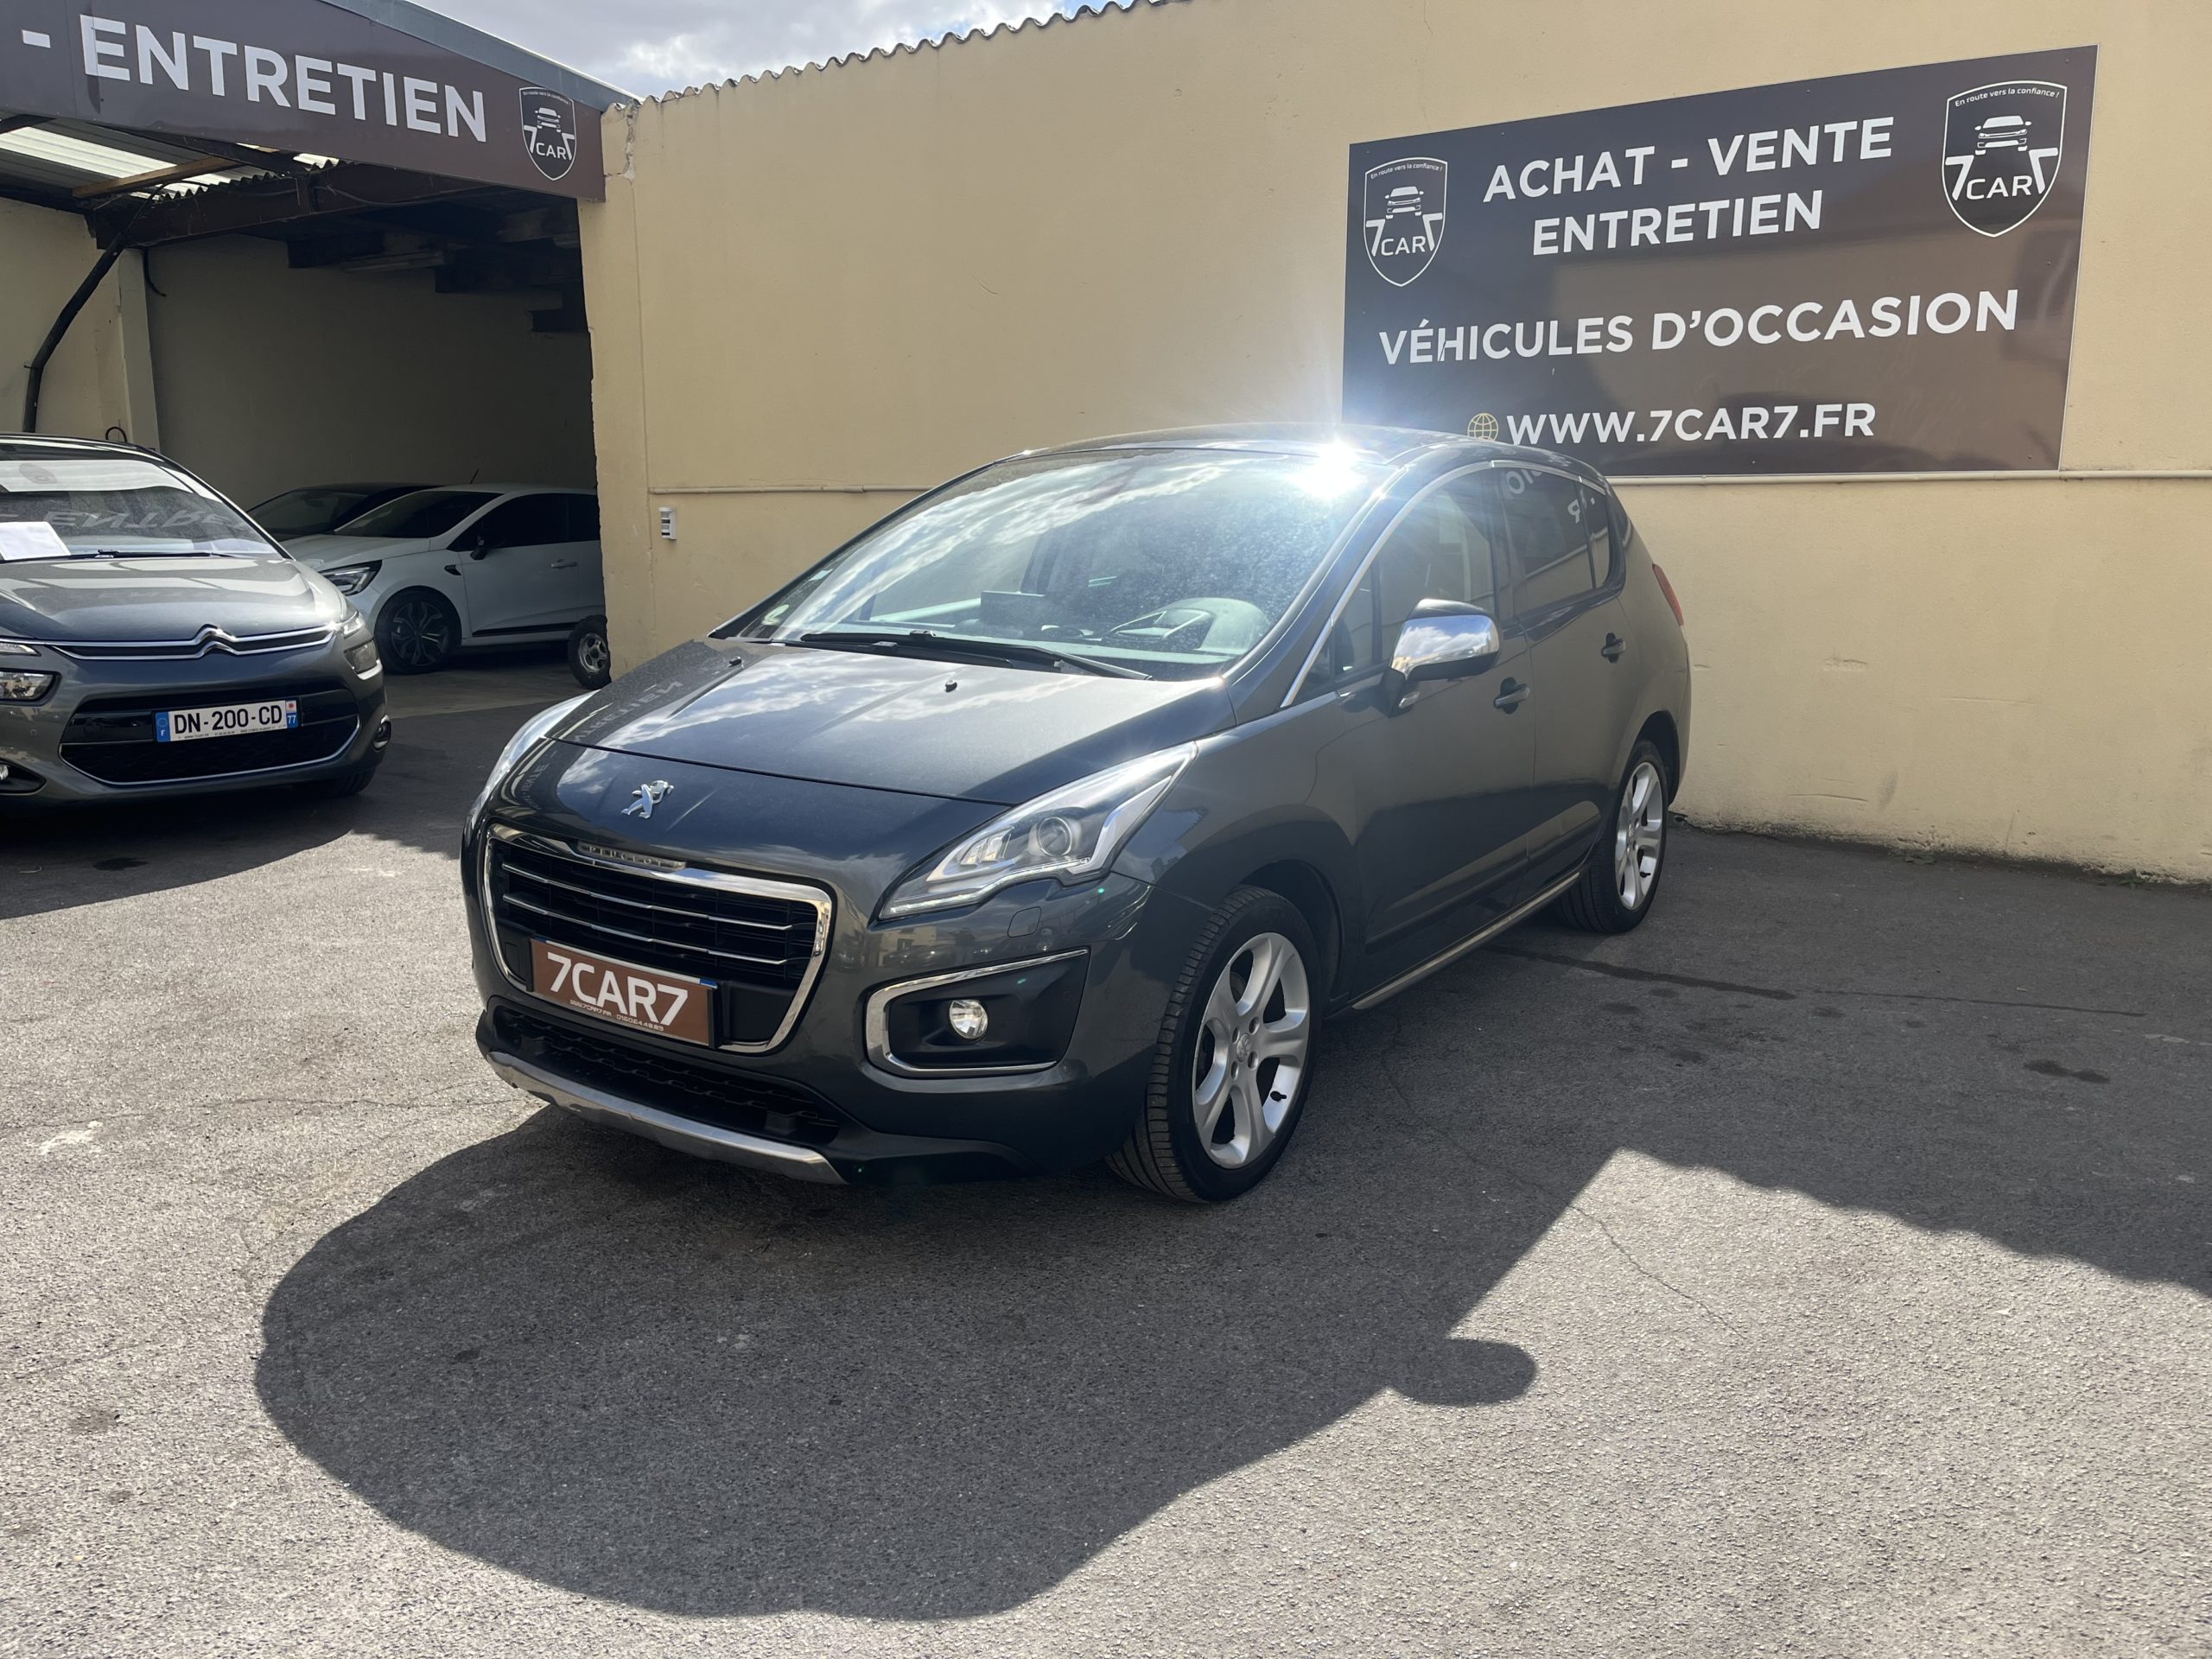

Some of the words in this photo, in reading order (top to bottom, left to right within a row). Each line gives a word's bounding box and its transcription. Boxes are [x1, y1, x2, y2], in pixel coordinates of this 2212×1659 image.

[79, 14, 486, 143] ENTRETIEN
[1955, 99, 1966, 108] En
[1967, 92, 1988, 103] route
[1989, 88, 2006, 98] vers
[2017, 87, 2056, 99] confiance
[1413, 162, 1440, 171] confiance
[1483, 145, 1656, 203] ACHAT
[1707, 117, 1894, 176] VENTE
[1533, 190, 1823, 256] ENTRETIEN
[1379, 319, 1634, 365] VÉHICULES
[1506, 403, 1876, 445] WWW.7CAR7.FR
[174, 704, 283, 734] DN-200-CD
[287, 715, 296, 724] 77
[589, 846, 662, 868] PEUGEOT
[547, 951, 688, 1027] 7CAR7
